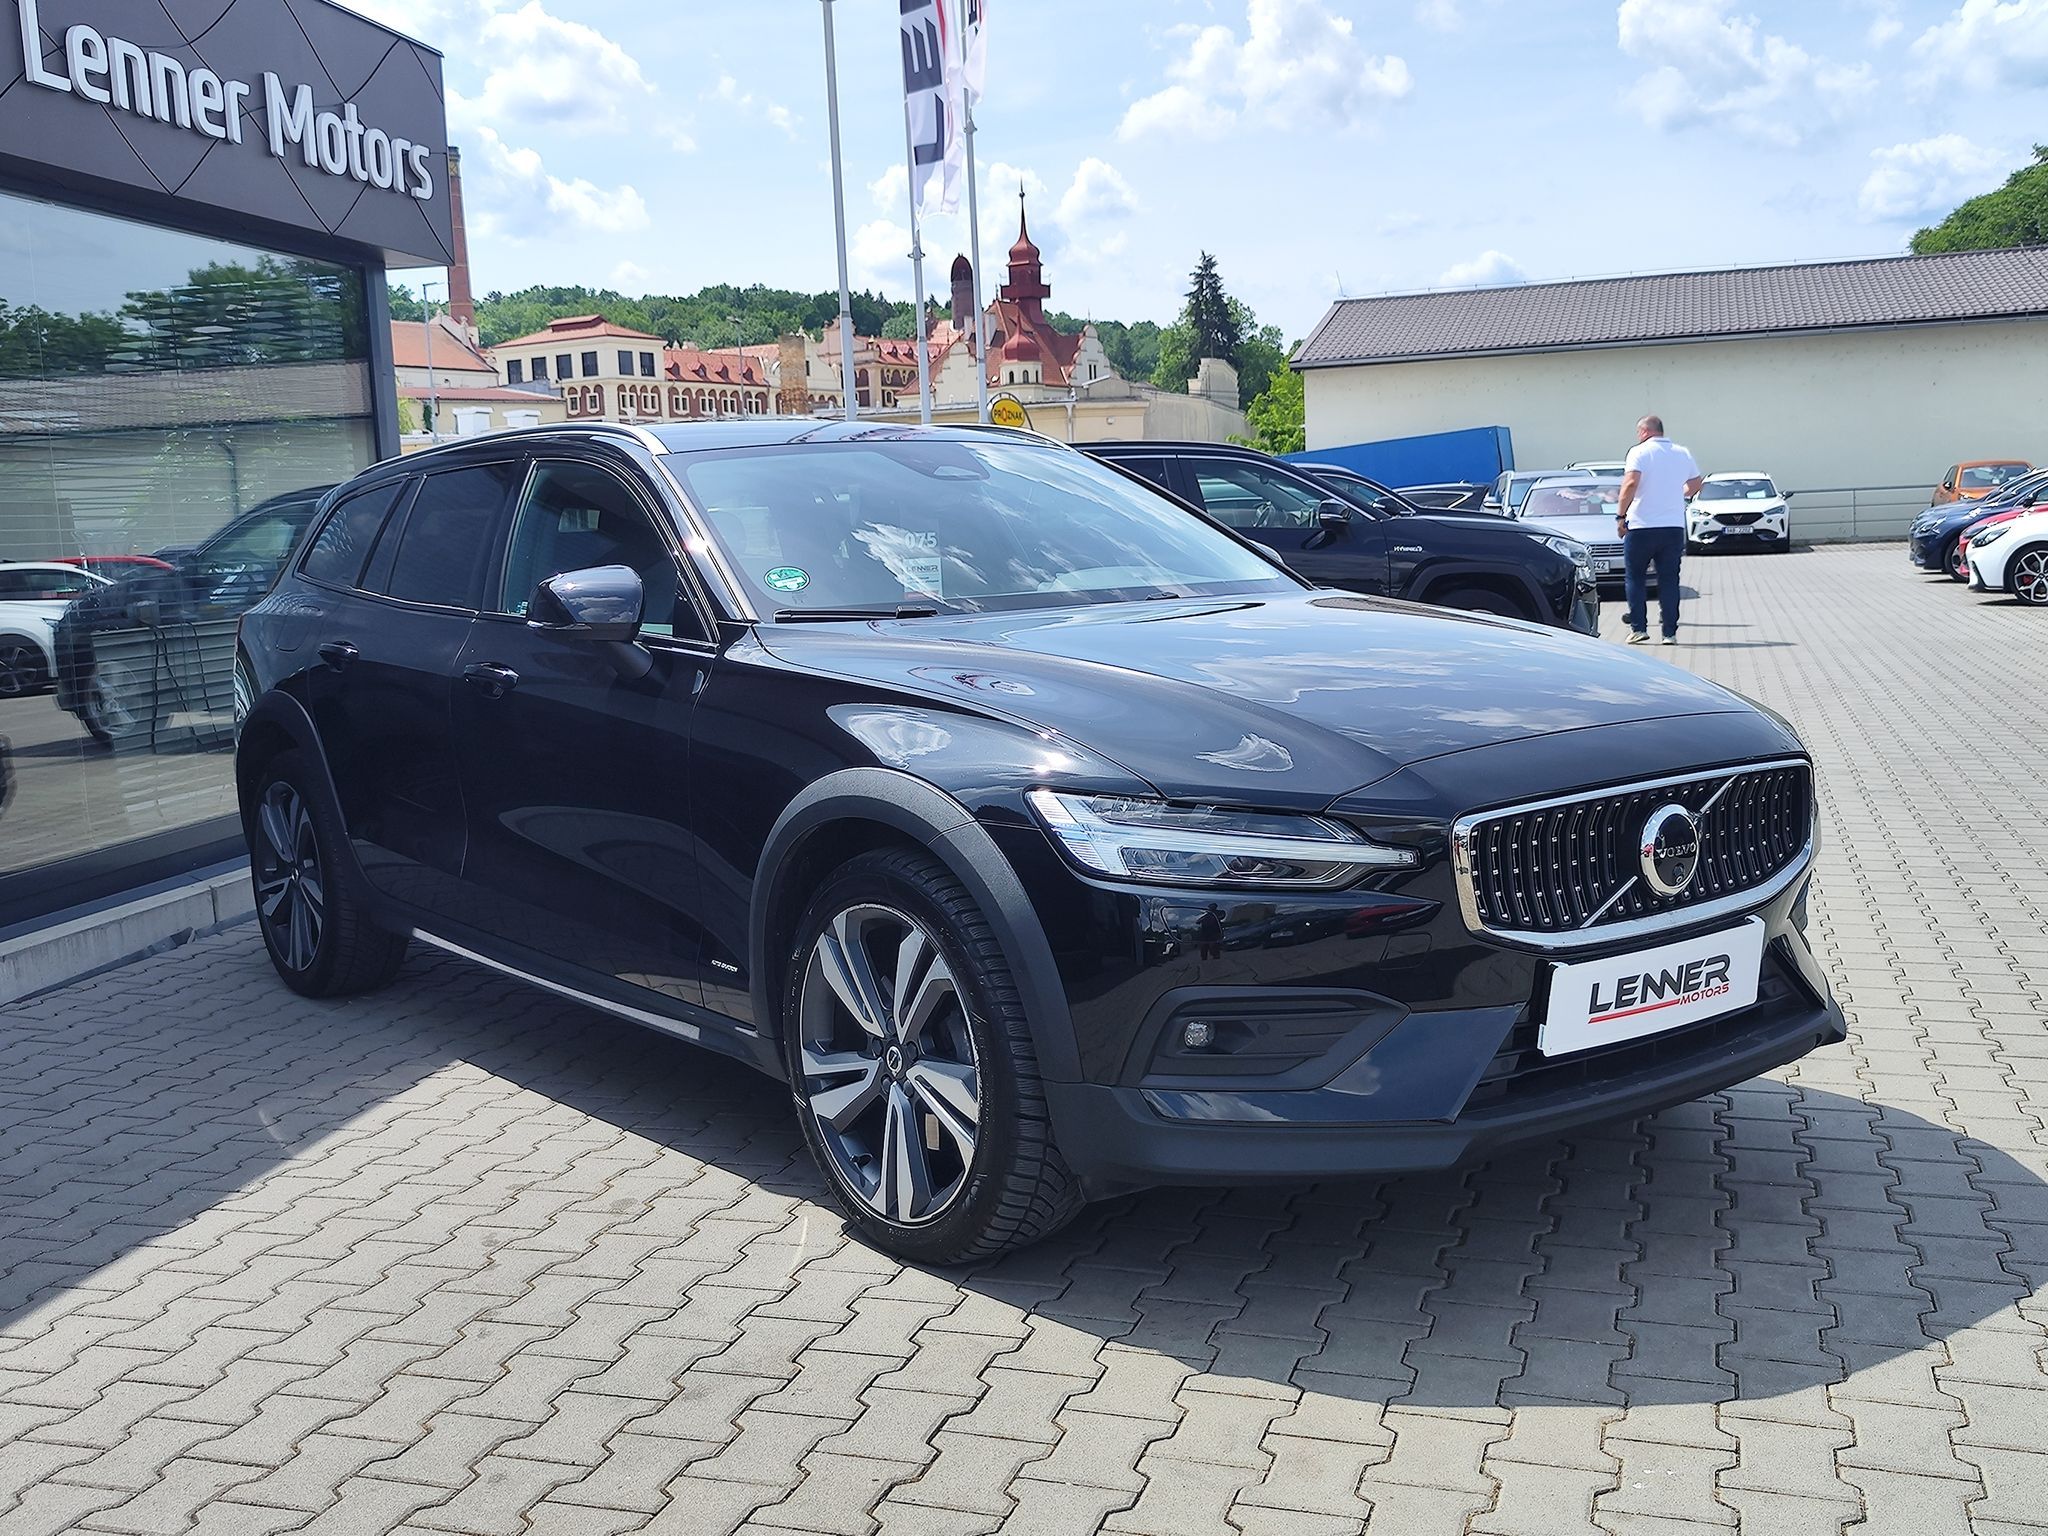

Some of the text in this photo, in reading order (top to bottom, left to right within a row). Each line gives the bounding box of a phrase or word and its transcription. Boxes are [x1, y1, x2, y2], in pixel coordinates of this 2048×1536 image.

[17, 0, 434, 200] Lenner Motors
[900, 0, 944, 165] LE
[904, 531, 938, 549] 075
[1657, 842, 1696, 859] VOLVO
[1589, 954, 1731, 1014] LENNER
[1680, 983, 1730, 1005] MOTORS
